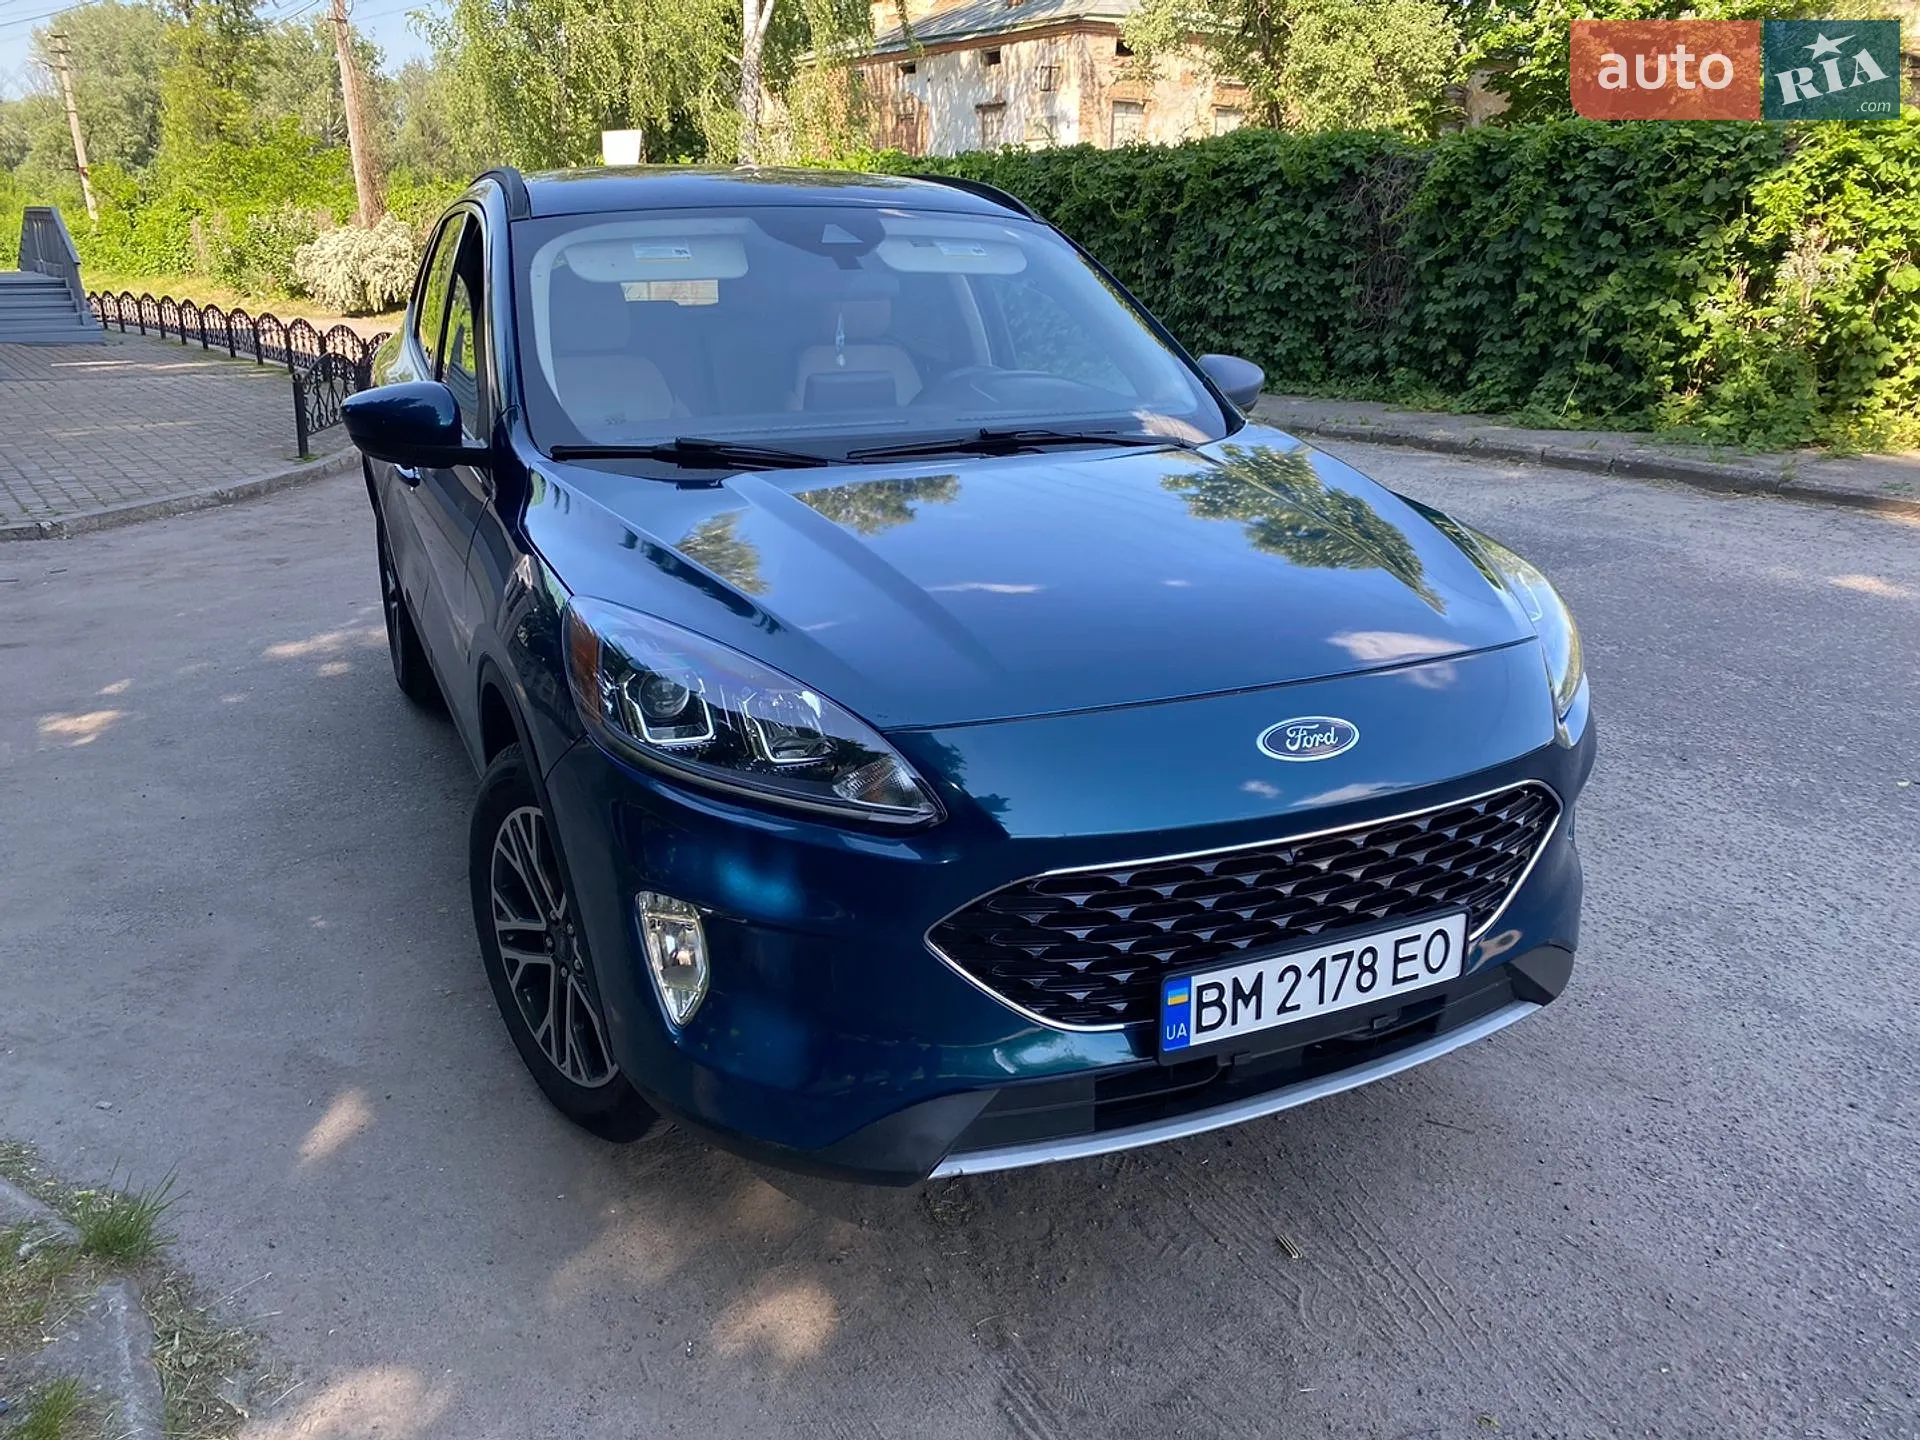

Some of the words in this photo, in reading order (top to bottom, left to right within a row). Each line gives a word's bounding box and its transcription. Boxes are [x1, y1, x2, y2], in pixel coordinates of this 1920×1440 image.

[1286, 724, 1339, 751] Ford
[1195, 971, 1263, 1035] BM
[1276, 945, 1379, 1015] 2178
[1391, 928, 1451, 986] EO
[1166, 1022, 1188, 1040] UA
